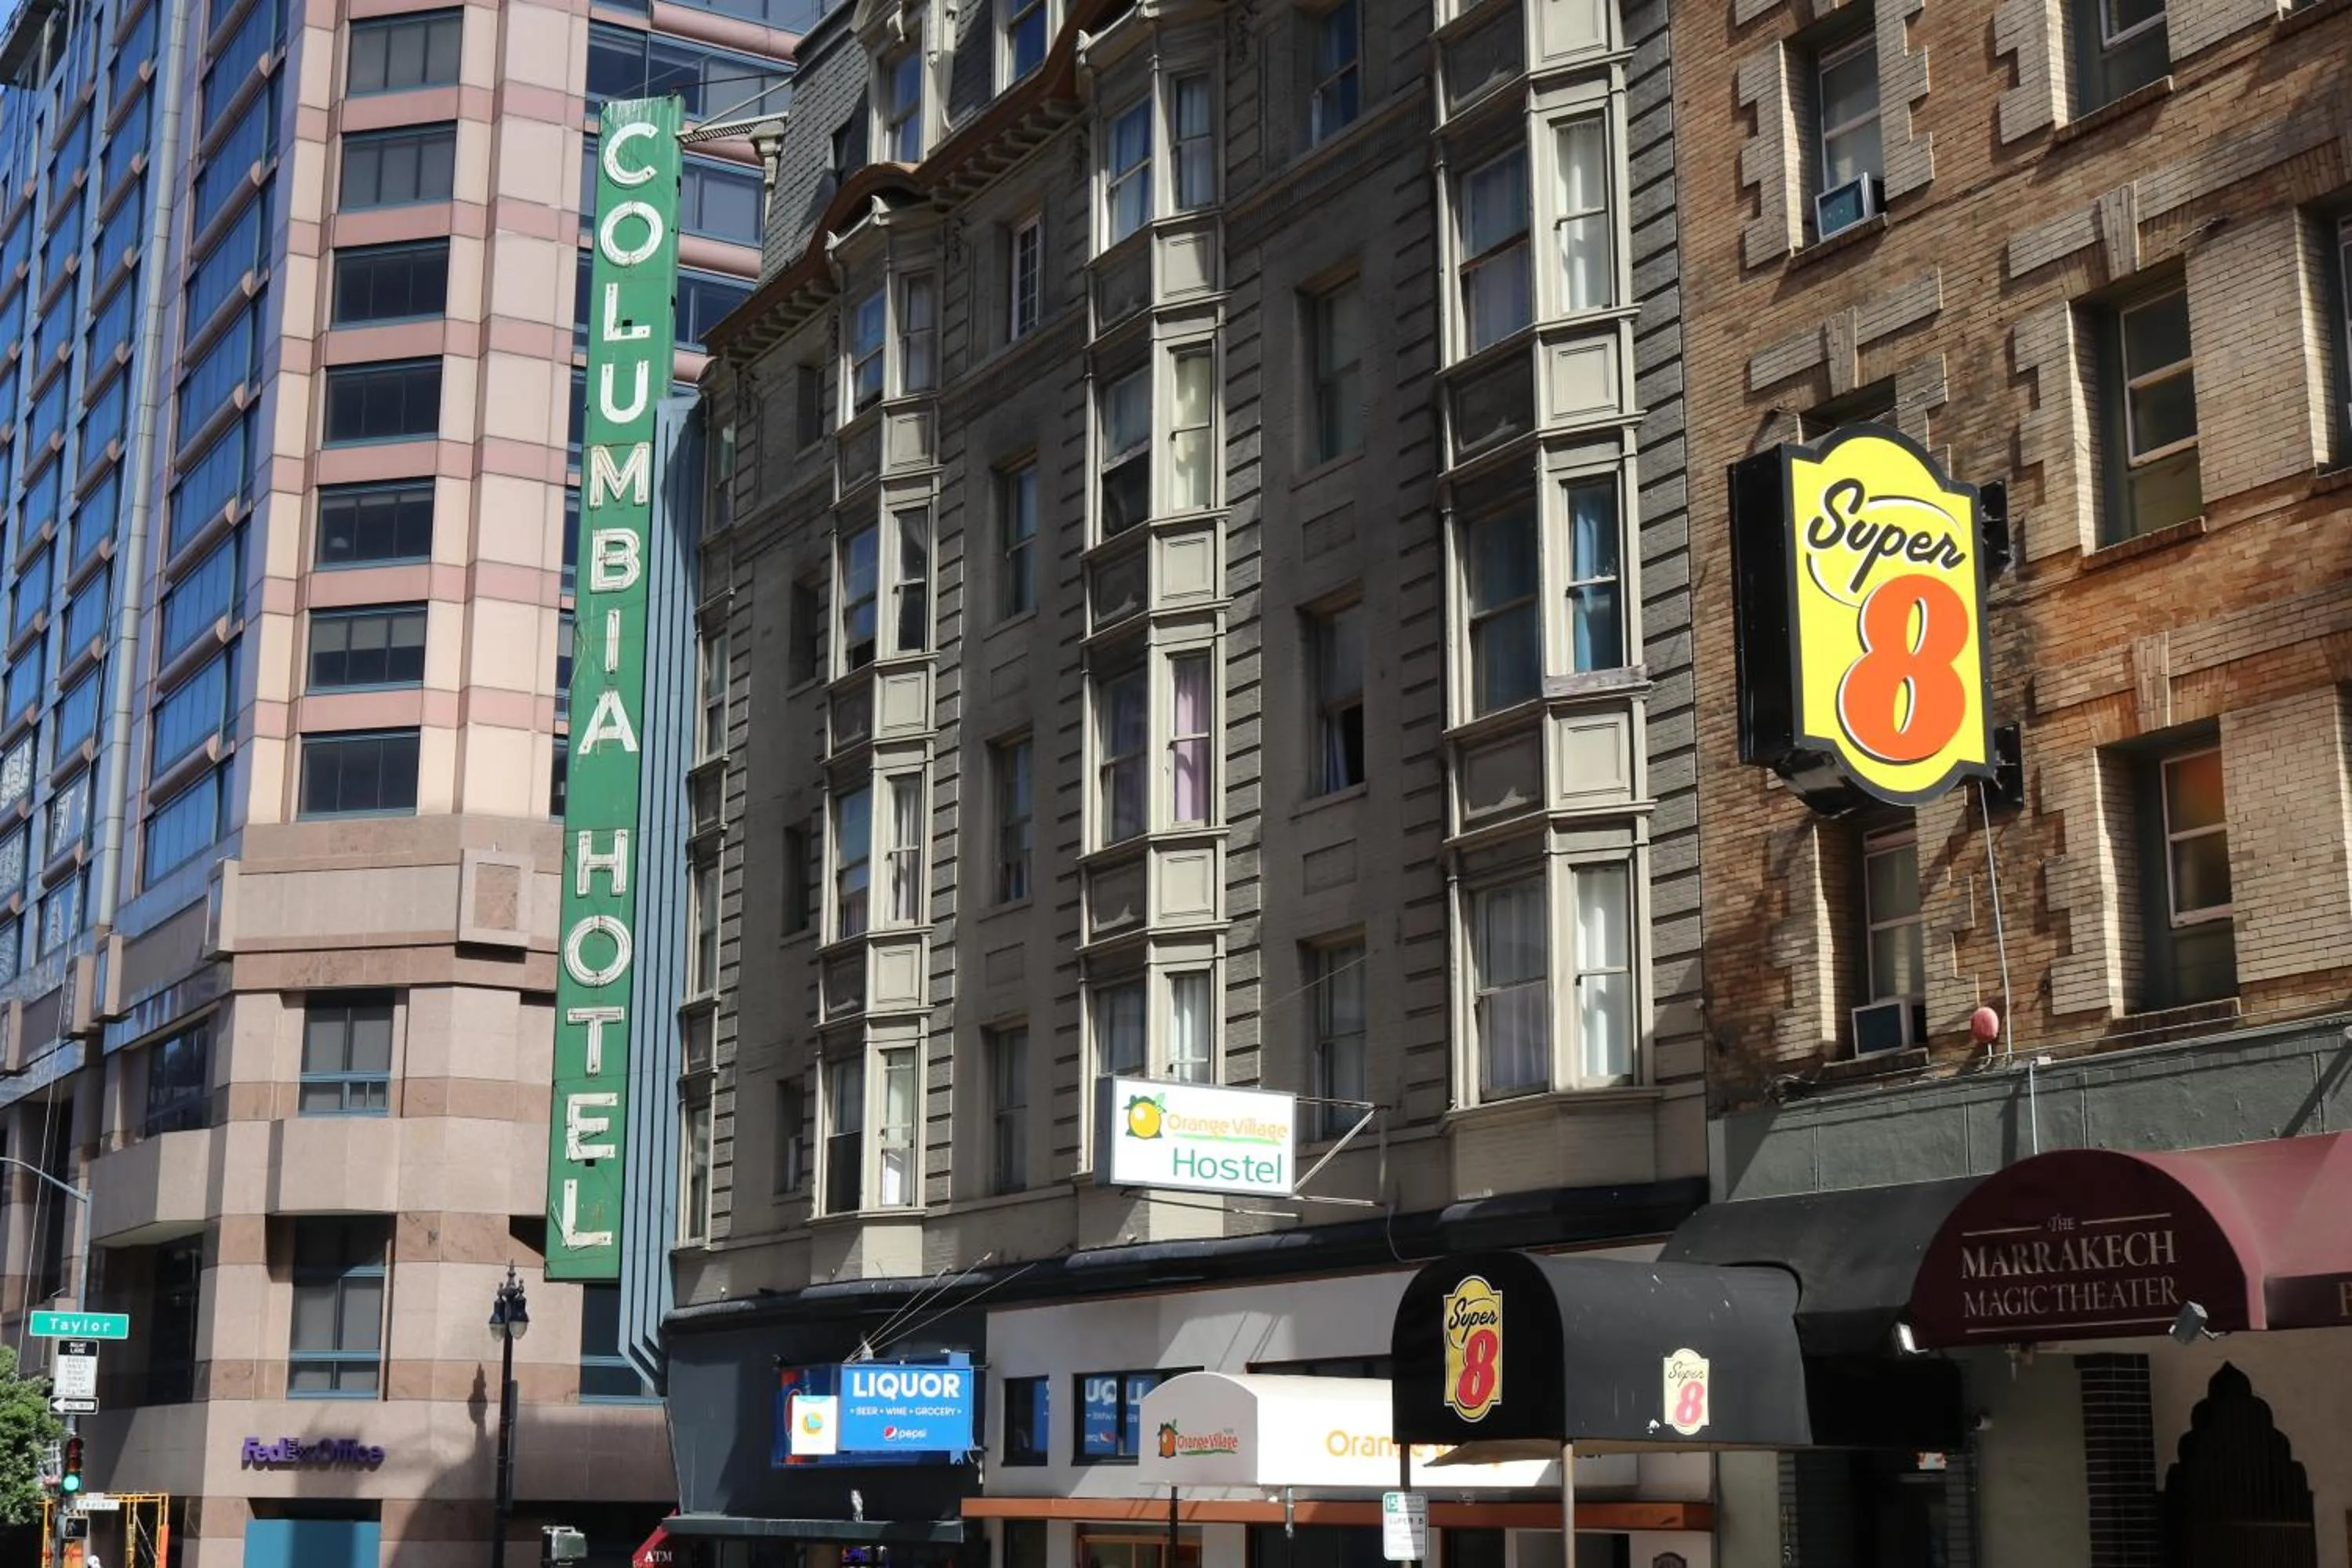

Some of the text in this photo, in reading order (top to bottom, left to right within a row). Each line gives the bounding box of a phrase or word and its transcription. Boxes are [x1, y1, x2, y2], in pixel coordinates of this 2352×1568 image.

[1806, 477, 1967, 593] Super
[561, 122, 664, 1248] COLUMBIA HOTEL
[1835, 573, 1969, 765] 8
[1167, 1113, 1288, 1140] Orange Village
[1173, 1147, 1282, 1185] Hostel
[2047, 1214, 2076, 1232] THE
[1961, 1229, 2177, 1279] MARRAKECH
[1962, 1276, 2180, 1319] MAGIC THEATER
[49, 1317, 111, 1334] Taylor
[1448, 1297, 1498, 1344] Super
[853, 1372, 961, 1401] LIQUOR
[1456, 1329, 1498, 1410] 8
[1668, 1360, 1705, 1388] Super
[855, 1406, 956, 1417] BEER WINE GROCERY
[1674, 1381, 1705, 1427] 8
[898, 1427, 927, 1439] pepsi
[242, 1436, 386, 1466] FedEx Office
[644, 1550, 673, 1563] ATM
